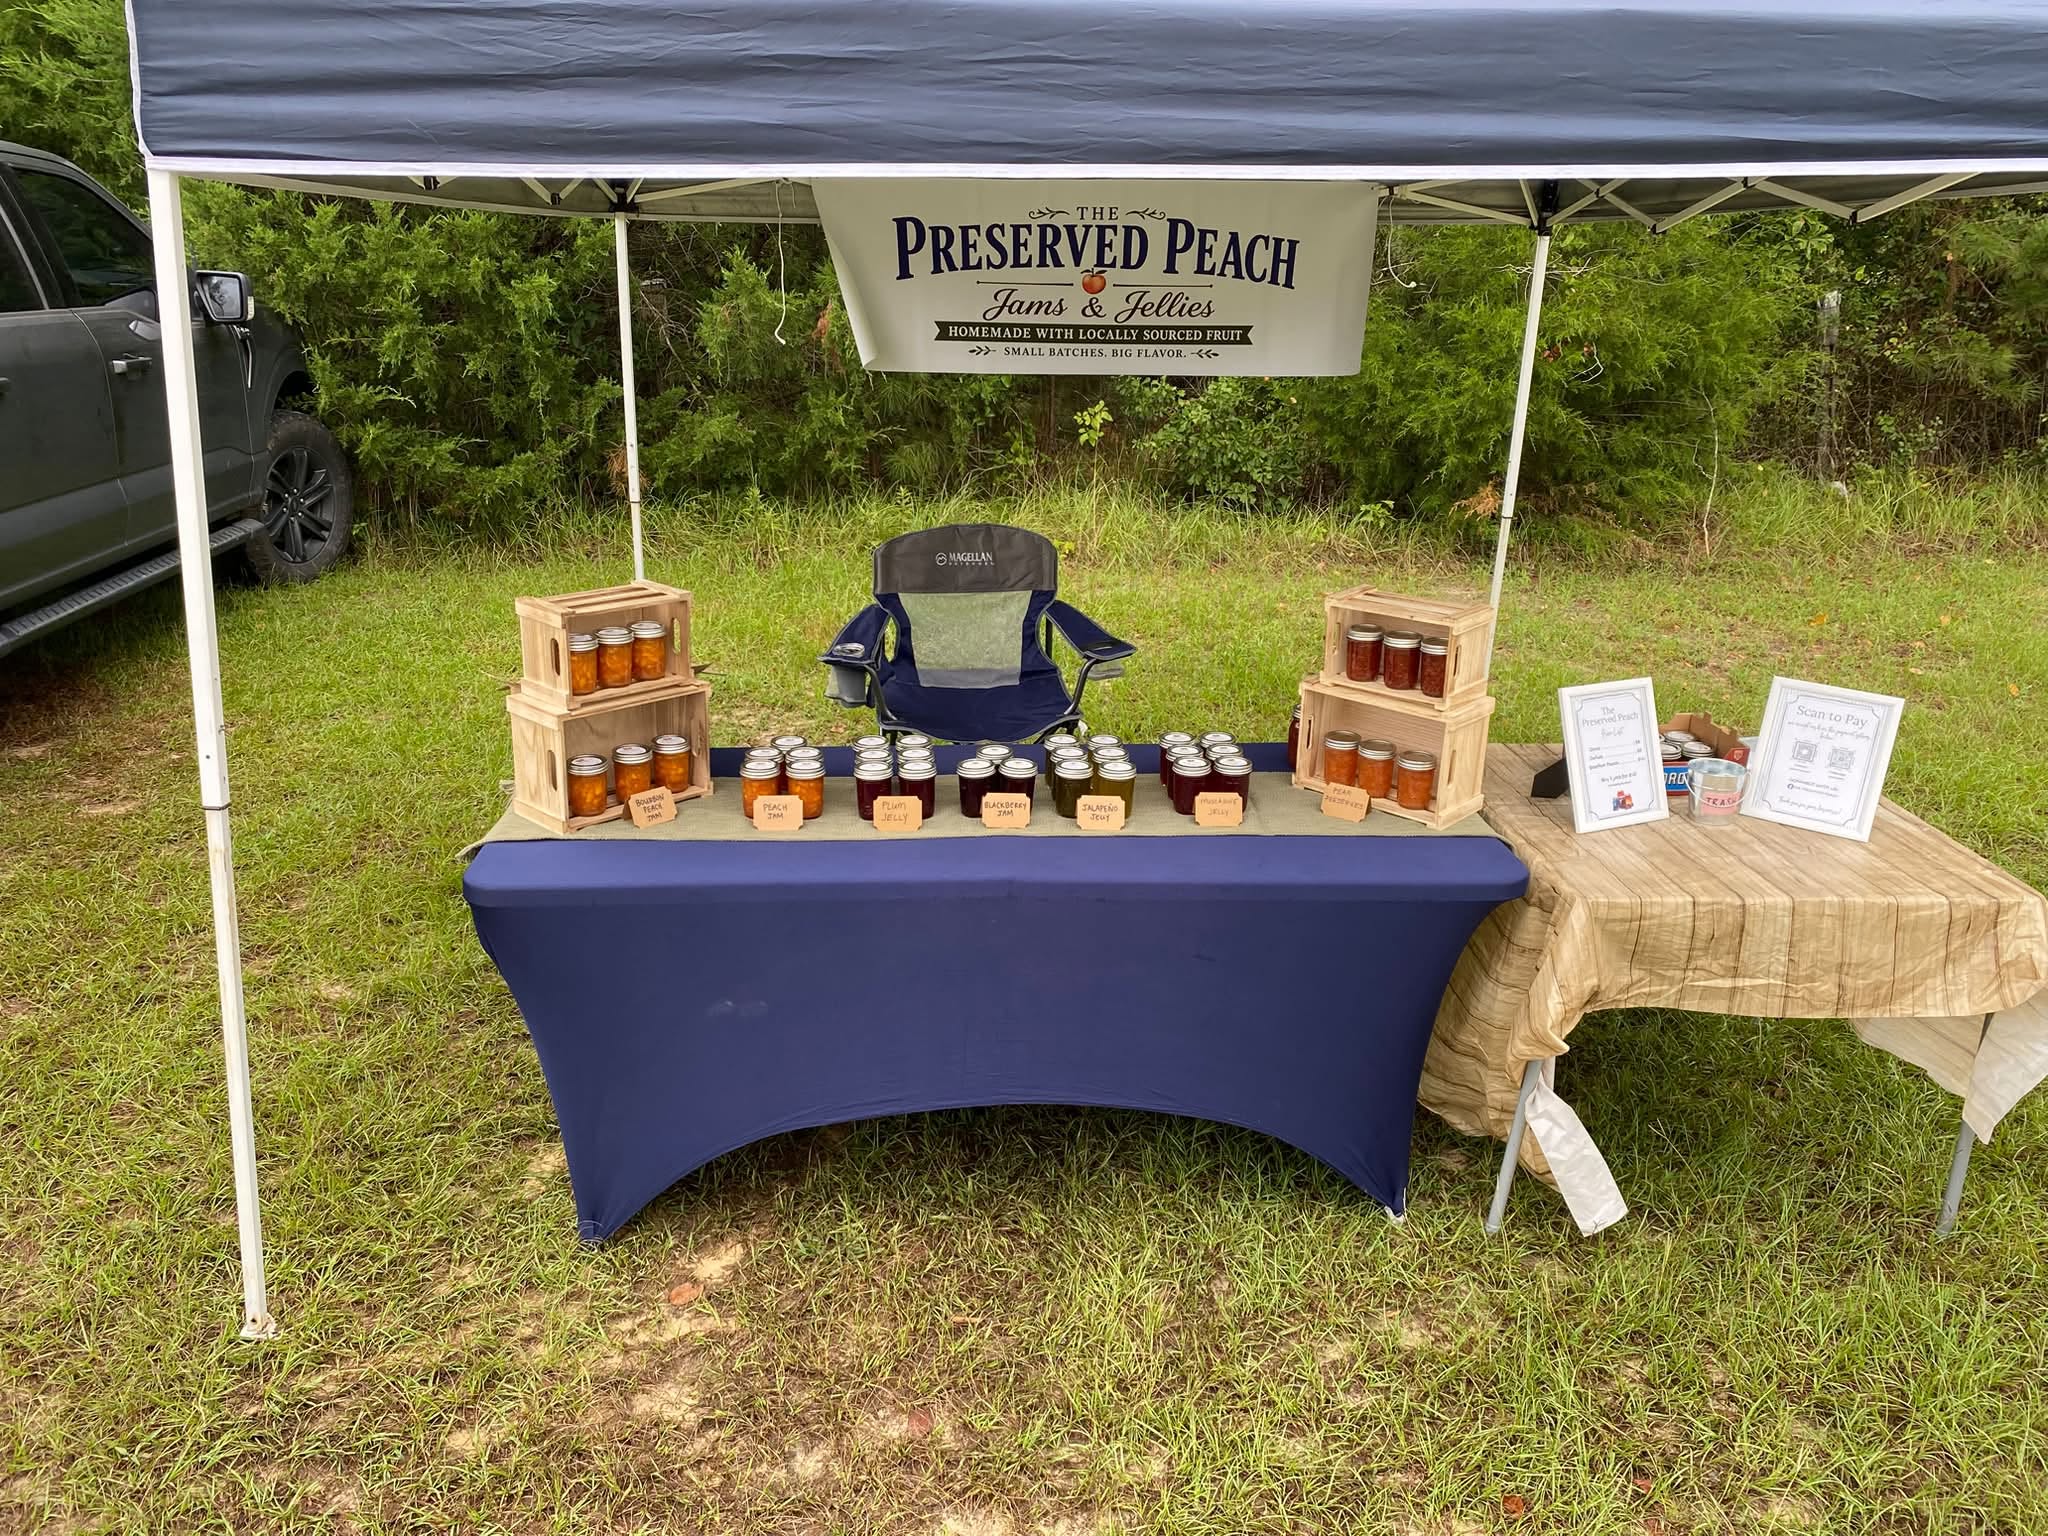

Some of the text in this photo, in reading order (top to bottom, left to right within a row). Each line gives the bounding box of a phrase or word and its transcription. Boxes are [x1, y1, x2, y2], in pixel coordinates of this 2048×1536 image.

[1076, 206, 1119, 221] THE
[892, 216, 1300, 290] PRESERVED PEACH
[982, 288, 1215, 324] Jams & Jellies
[949, 325, 1243, 341] HOMEMADE WITH LOCALLY SOURCED FRUIT
[1004, 346, 1187, 358] SMALL BATCHES. BIG FLAVOR.
[949, 552, 993, 562] MAGELLAN
[1796, 704, 1868, 729] Scan to Pay
[763, 803, 788, 812] PEACH
[767, 812, 784, 820] JAM
